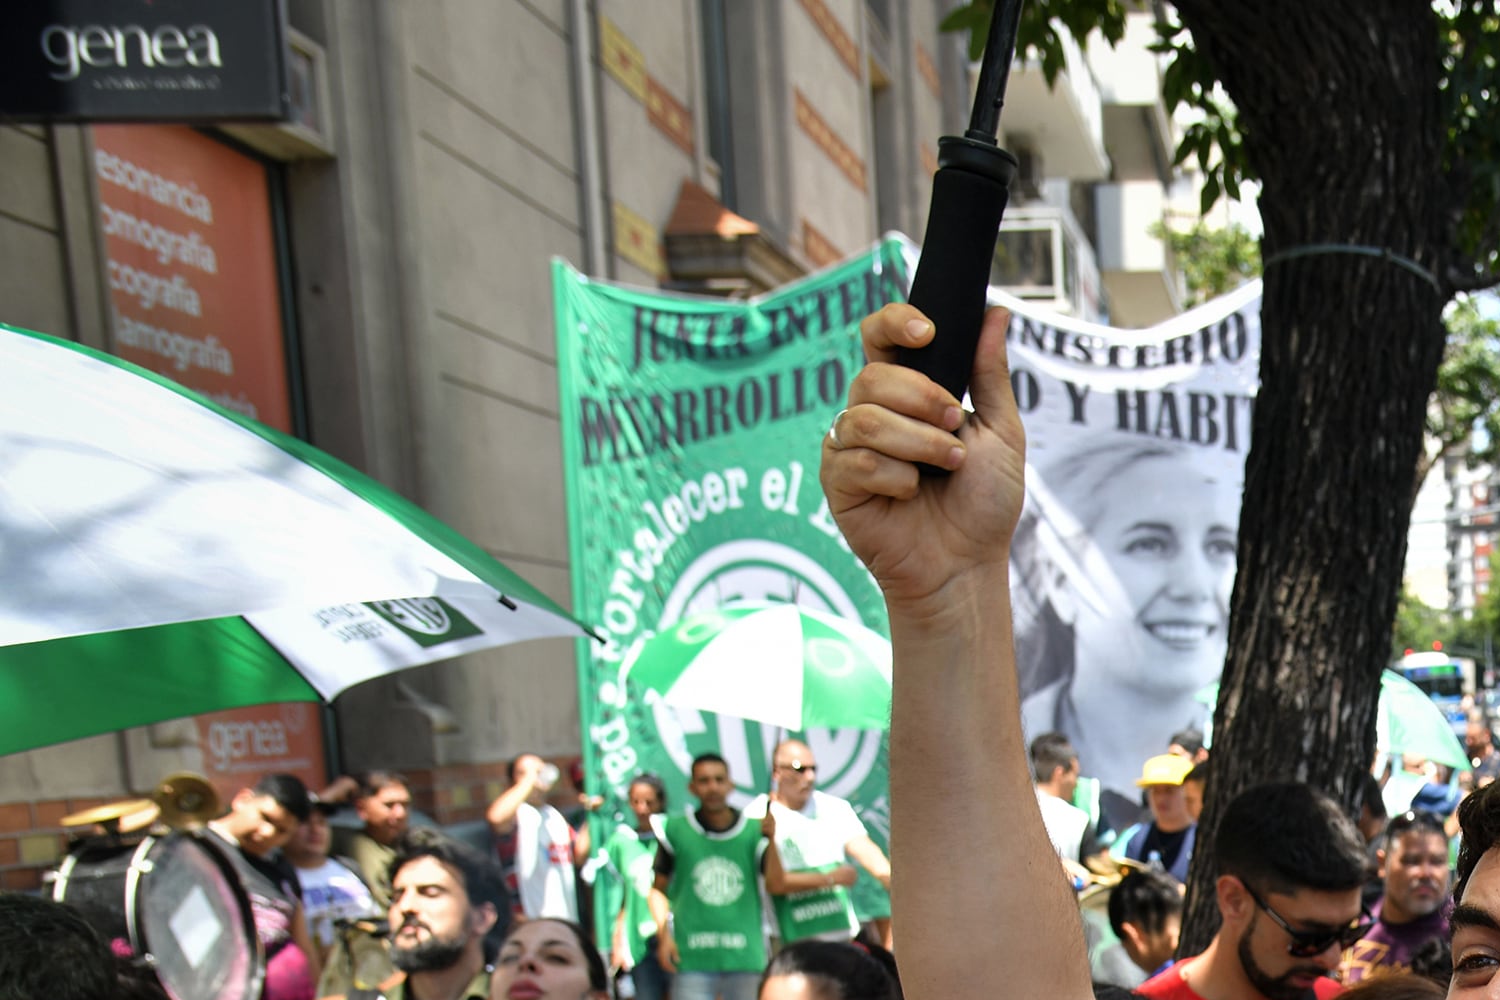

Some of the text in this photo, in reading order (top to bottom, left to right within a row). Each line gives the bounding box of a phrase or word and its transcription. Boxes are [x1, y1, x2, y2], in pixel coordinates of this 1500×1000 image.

[41, 24, 223, 81] genea
[1006, 310, 1249, 368] NISTERIO
[1063, 379, 1092, 426] Y
[758, 460, 804, 516] el
[208, 719, 289, 771] genea
[589, 720, 640, 801] pa
